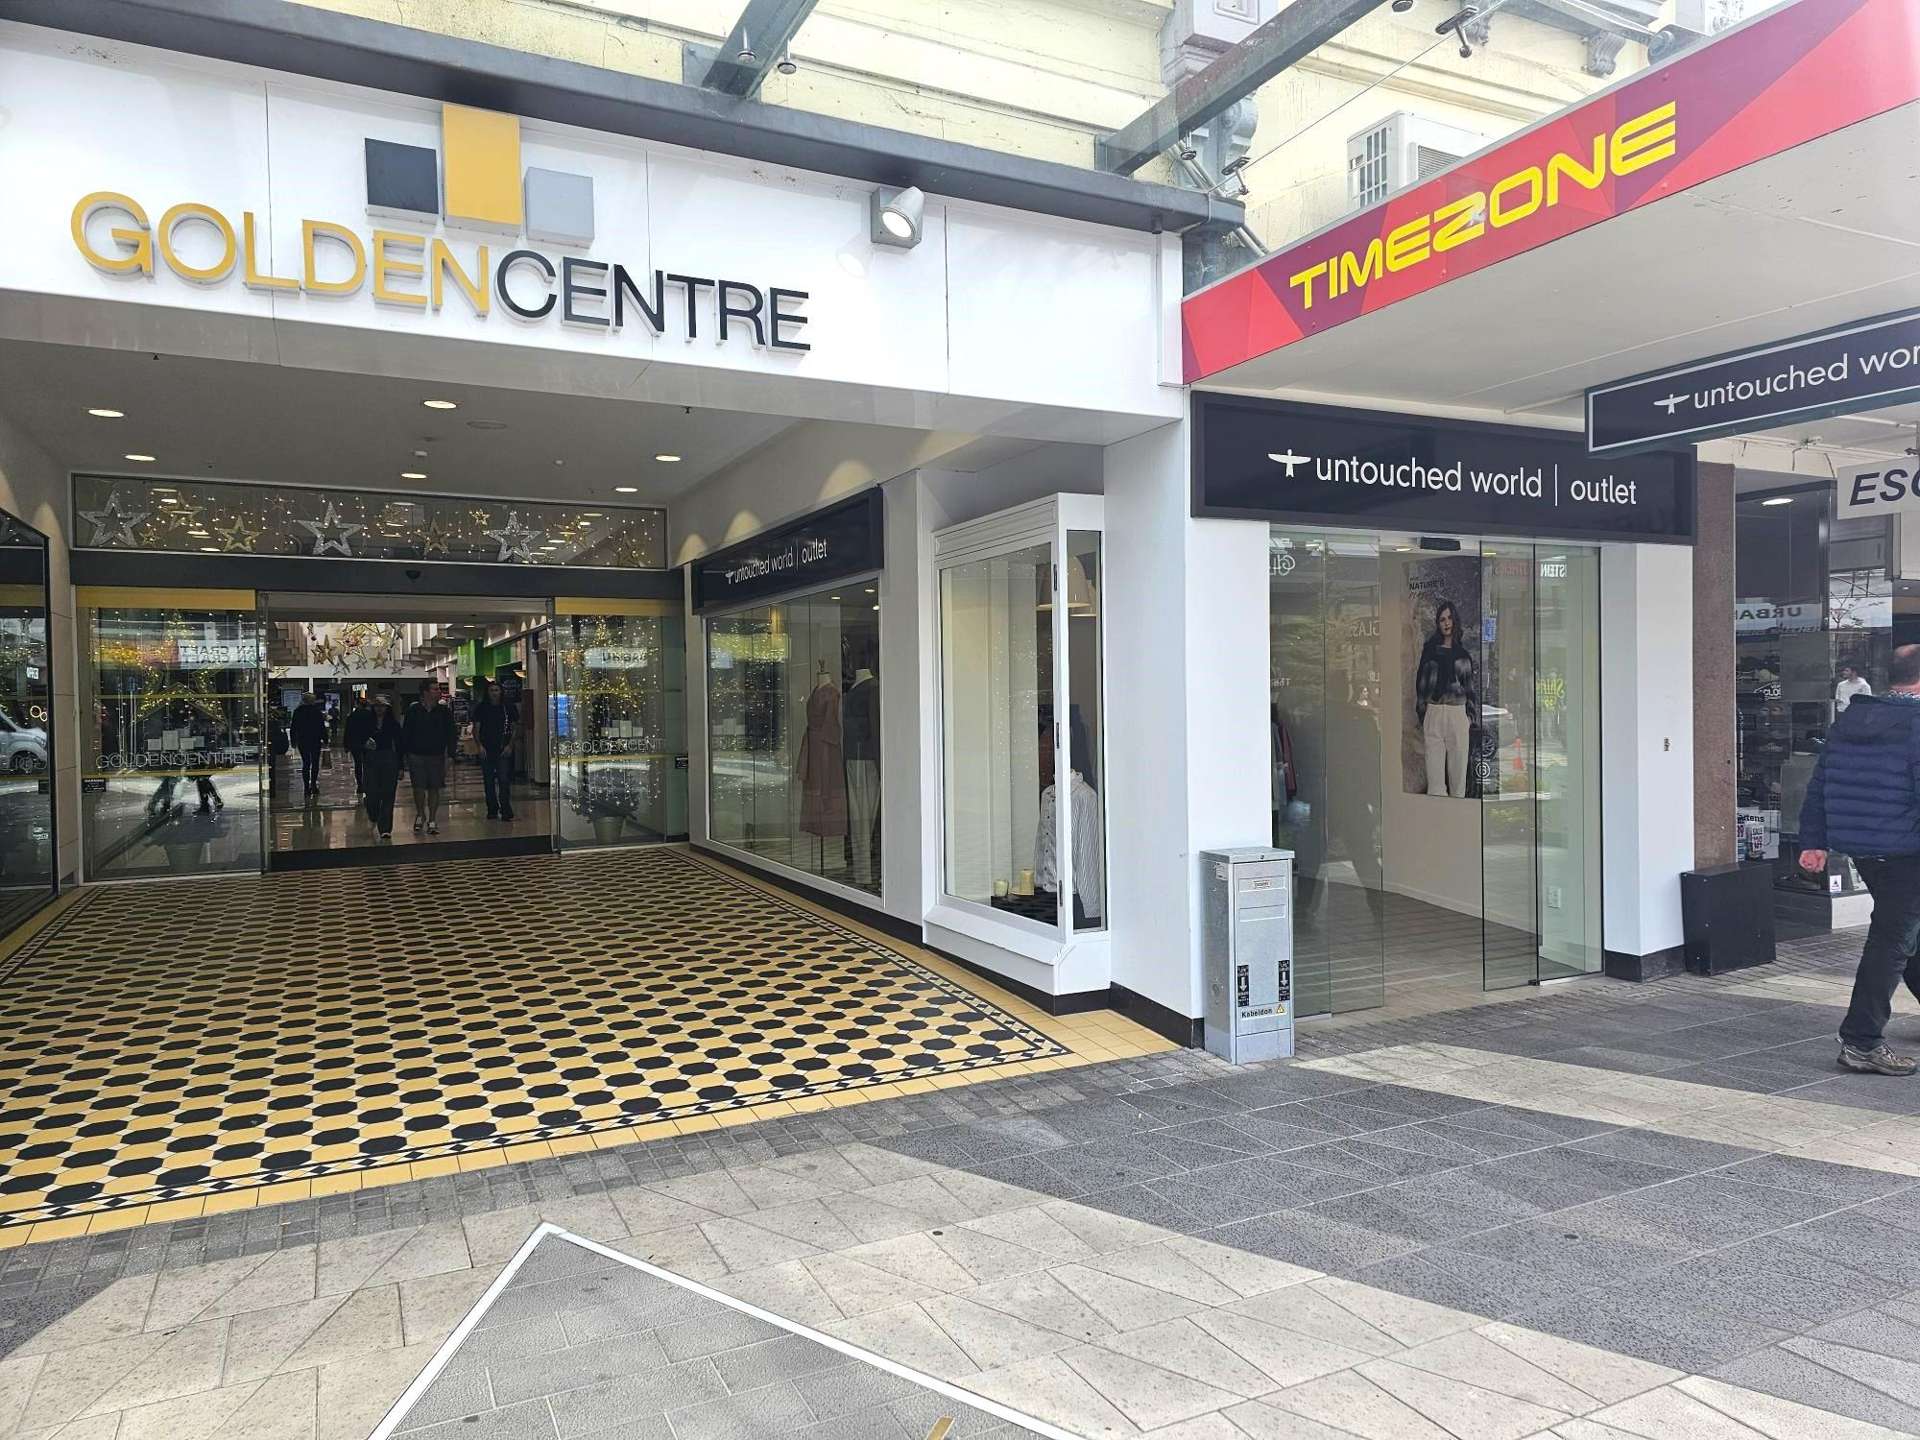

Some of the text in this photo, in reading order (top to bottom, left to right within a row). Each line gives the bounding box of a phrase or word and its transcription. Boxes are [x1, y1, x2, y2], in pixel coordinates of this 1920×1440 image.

[1289, 100, 1676, 309] TIMEZONE
[1693, 352, 1849, 410] untouched
[1315, 456, 1637, 505] untouched world outlet
[734, 538, 828, 583] untouched world outlet
